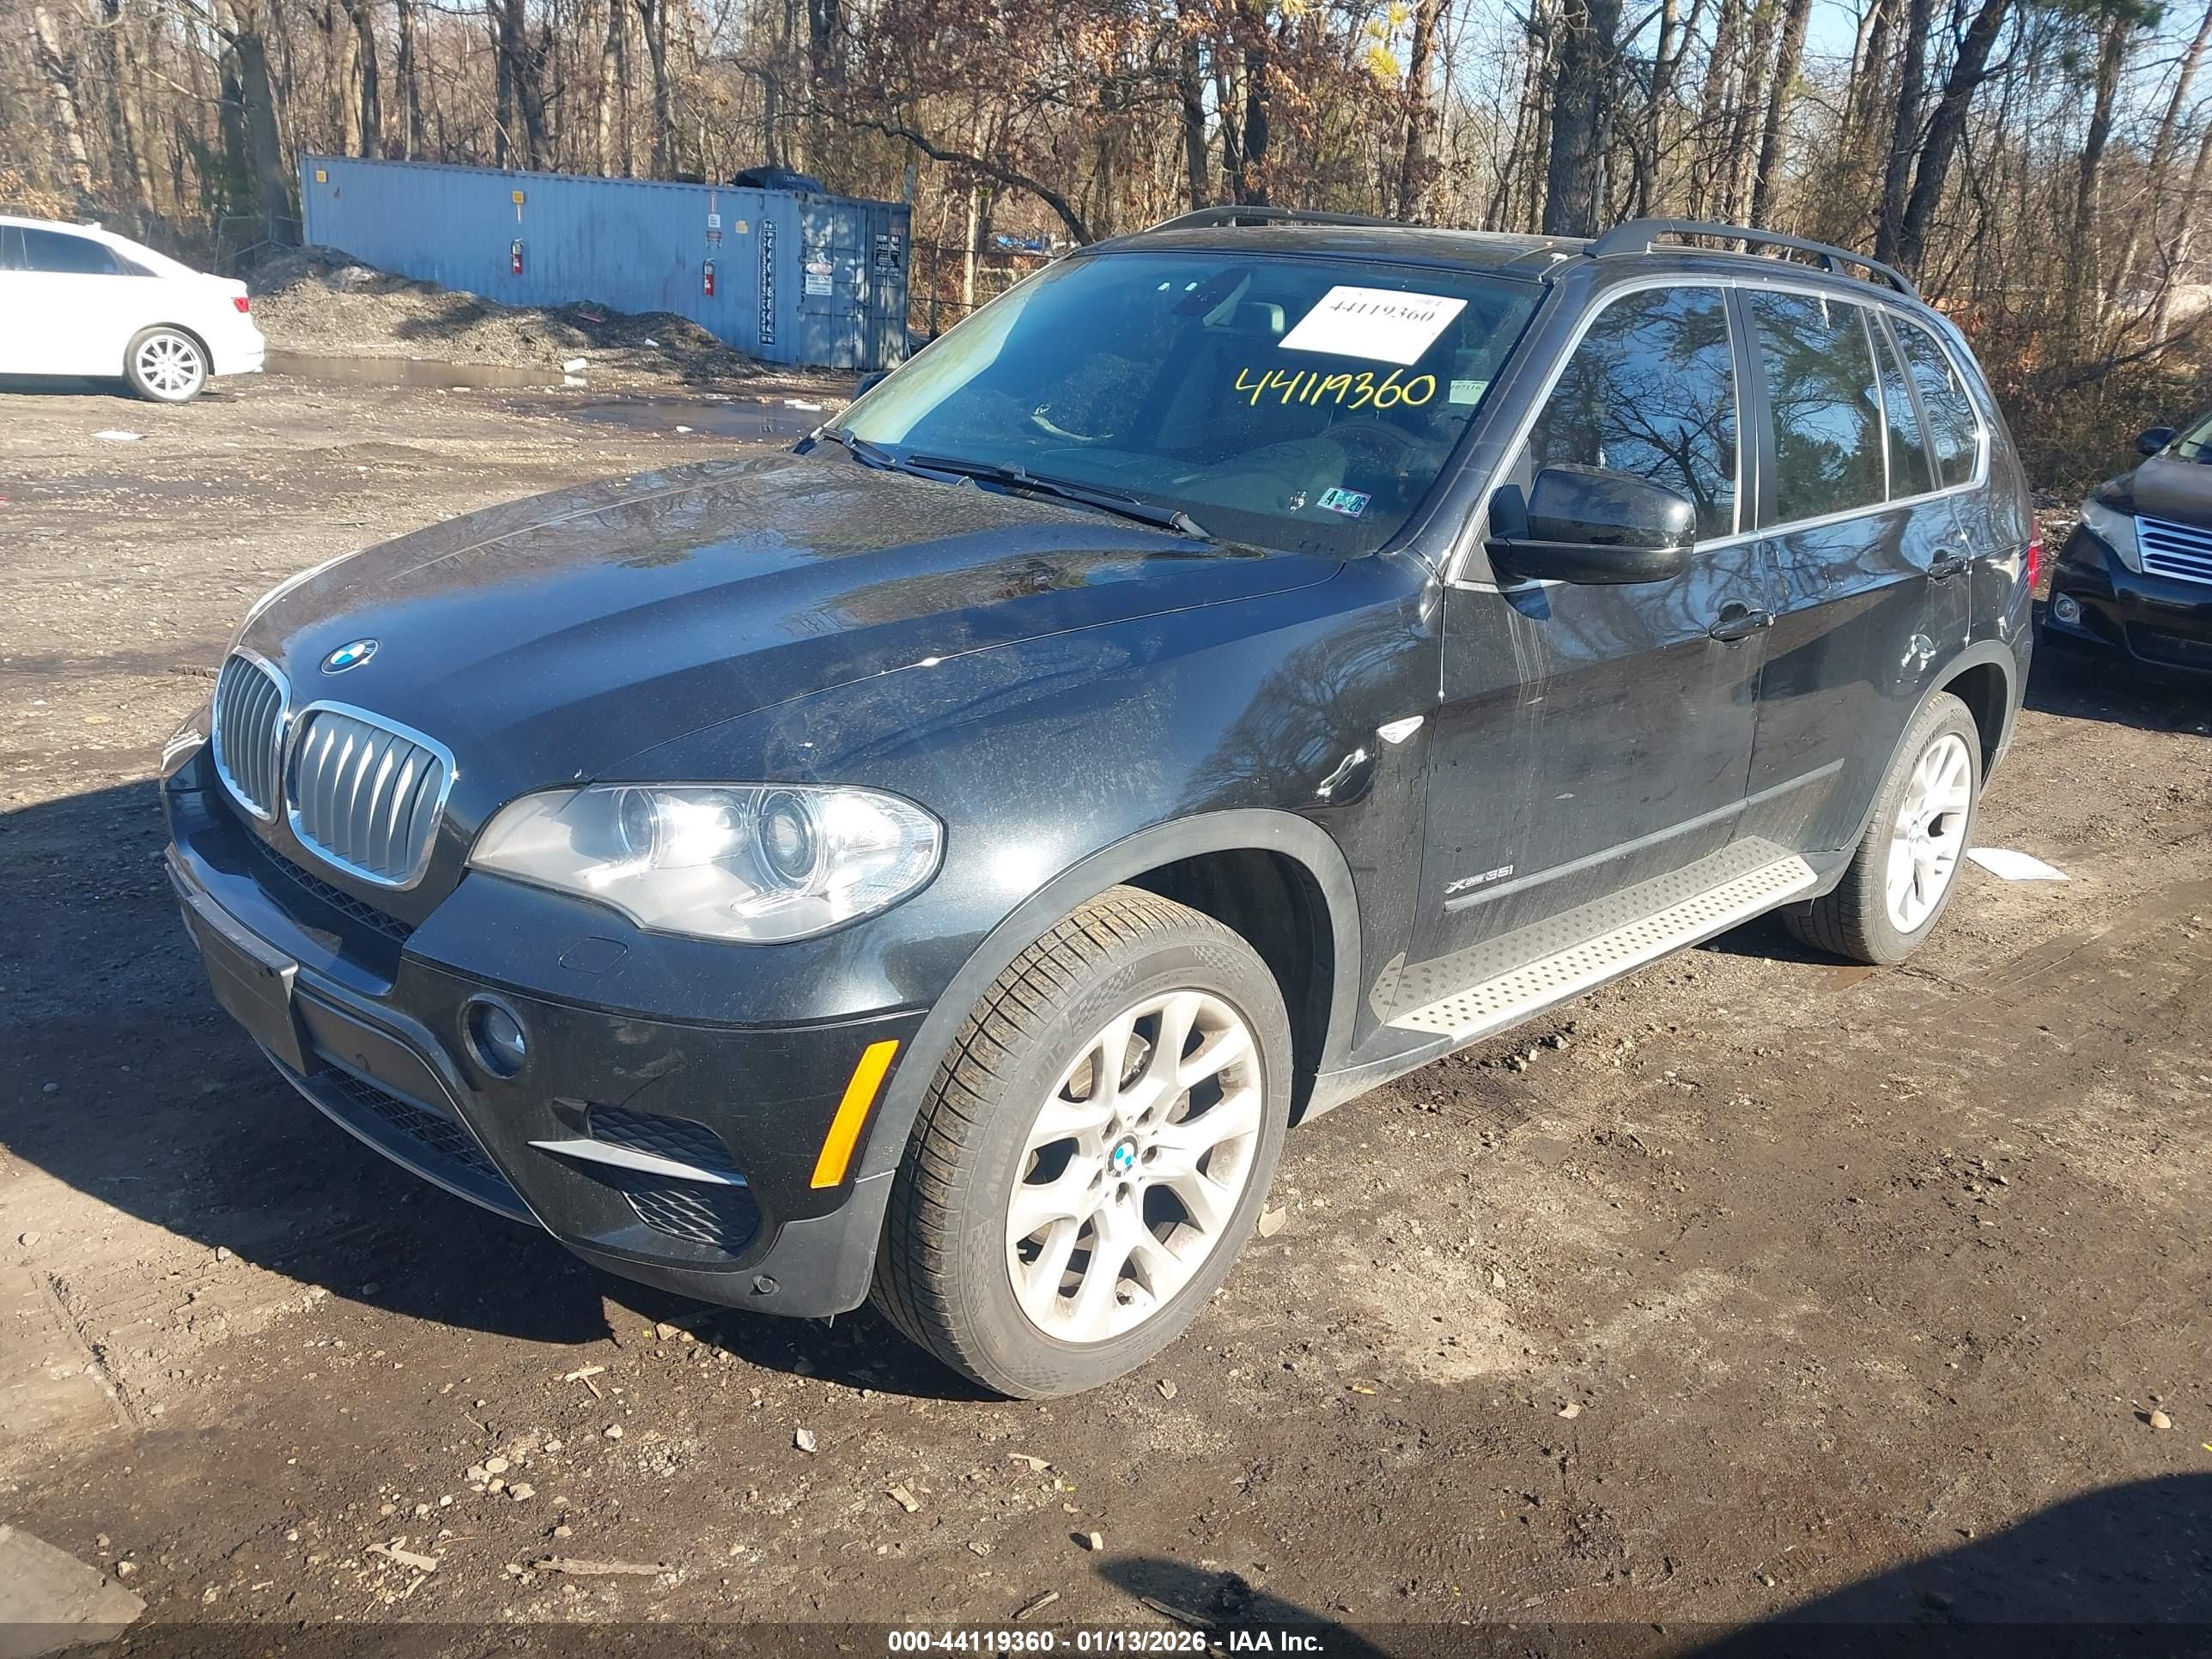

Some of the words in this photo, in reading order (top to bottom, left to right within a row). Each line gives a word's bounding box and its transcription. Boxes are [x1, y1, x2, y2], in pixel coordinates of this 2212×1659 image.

[1329, 300, 1435, 322] 44119360
[1236, 368, 1436, 409] 44119360
[1327, 490, 1339, 505] 4
